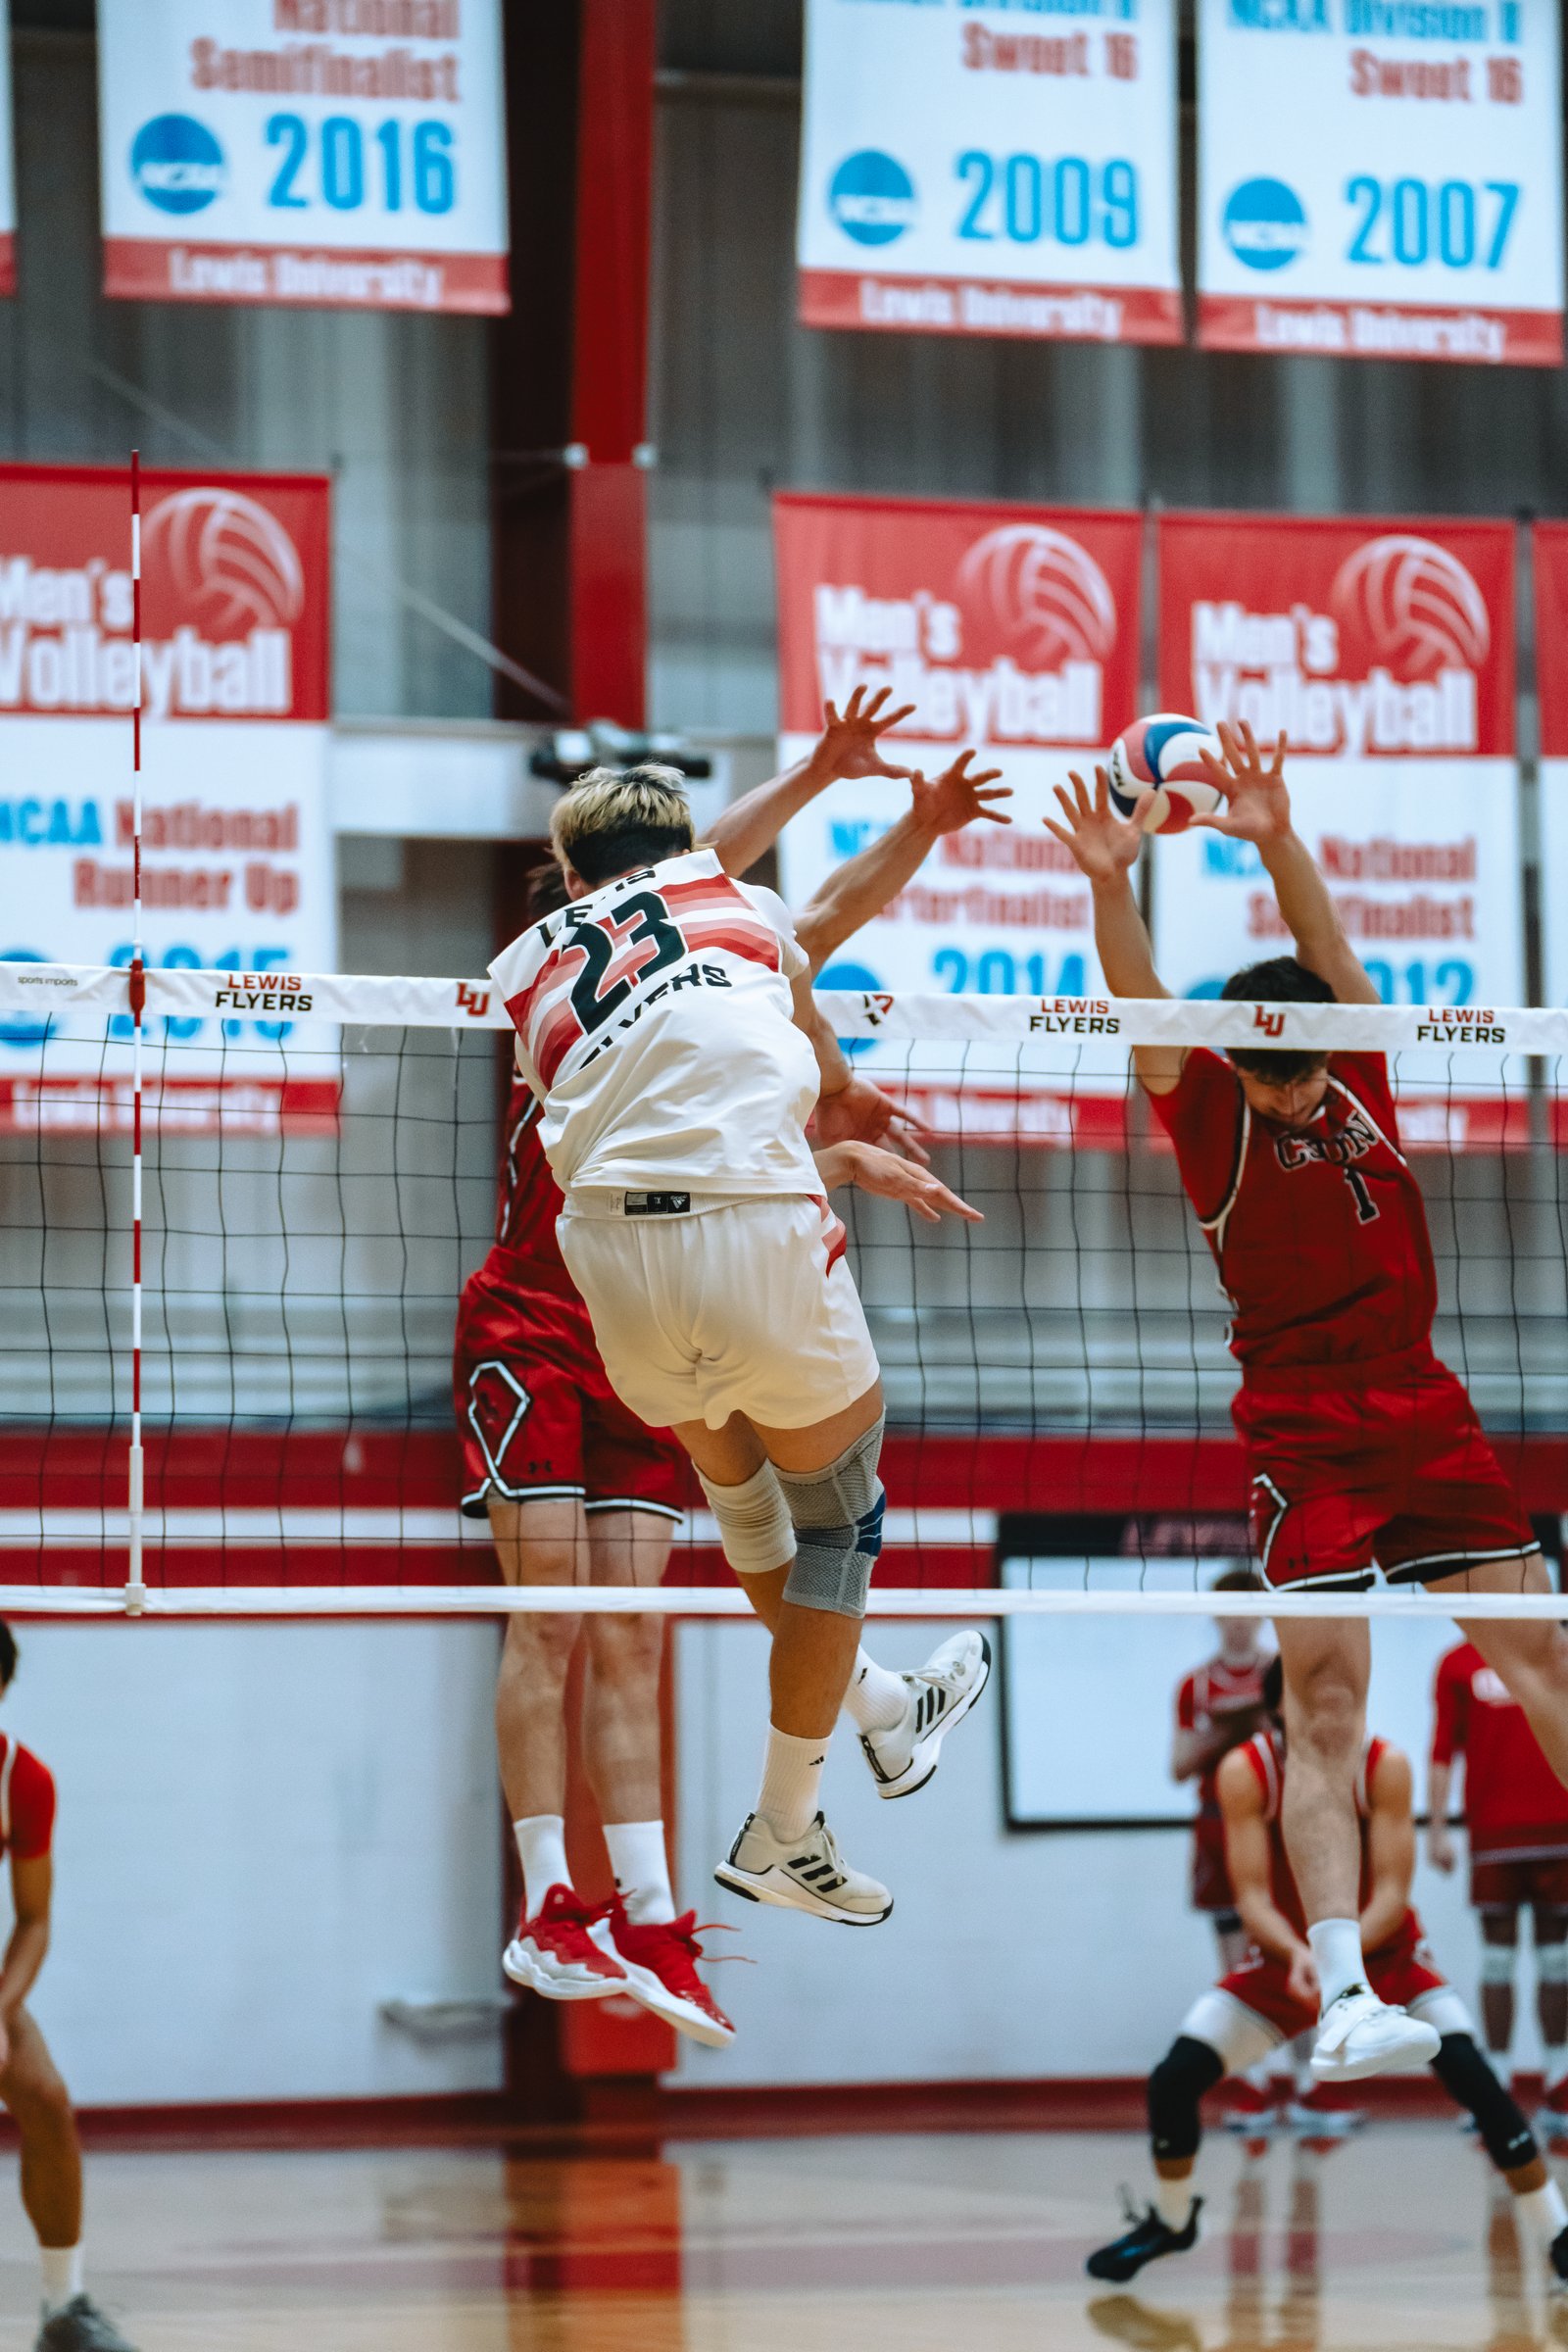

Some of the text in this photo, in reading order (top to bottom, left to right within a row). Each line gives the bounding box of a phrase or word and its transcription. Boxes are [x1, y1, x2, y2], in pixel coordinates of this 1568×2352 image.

[189, 37, 461, 103] Semifinalist
[961, 21, 1090, 77] Sweet
[1349, 47, 1472, 103] Sweet
[264, 113, 457, 216] 2016
[956, 149, 1139, 249] 2009
[1345, 175, 1521, 270] 2007
[168, 247, 268, 295] Lewis
[859, 277, 955, 324] Lewis
[1255, 303, 1346, 344] Lewis
[814, 584, 960, 660] Men's
[1192, 599, 1339, 674] Men's
[114, 797, 299, 853] National
[942, 826, 1081, 875] Nationa
[1319, 833, 1477, 882] National
[244, 859, 300, 916] Up
[536, 869, 657, 949] LEIS
[18, 976, 43, 985] sports
[228, 974, 302, 992] LEWIS
[561, 890, 690, 1037] 23
[215, 991, 314, 1012] FLYERS
[456, 982, 491, 1017] LU
[579, 962, 734, 1070] YERS
[1029, 1015, 1121, 1035] FLYERS
[1041, 999, 1109, 1014] LEWIS
[1253, 1004, 1286, 1037] LU
[1429, 1008, 1495, 1023] LEWIS
[1417, 1025, 1506, 1044] FLYERS
[1343, 1166, 1381, 1225] 1
